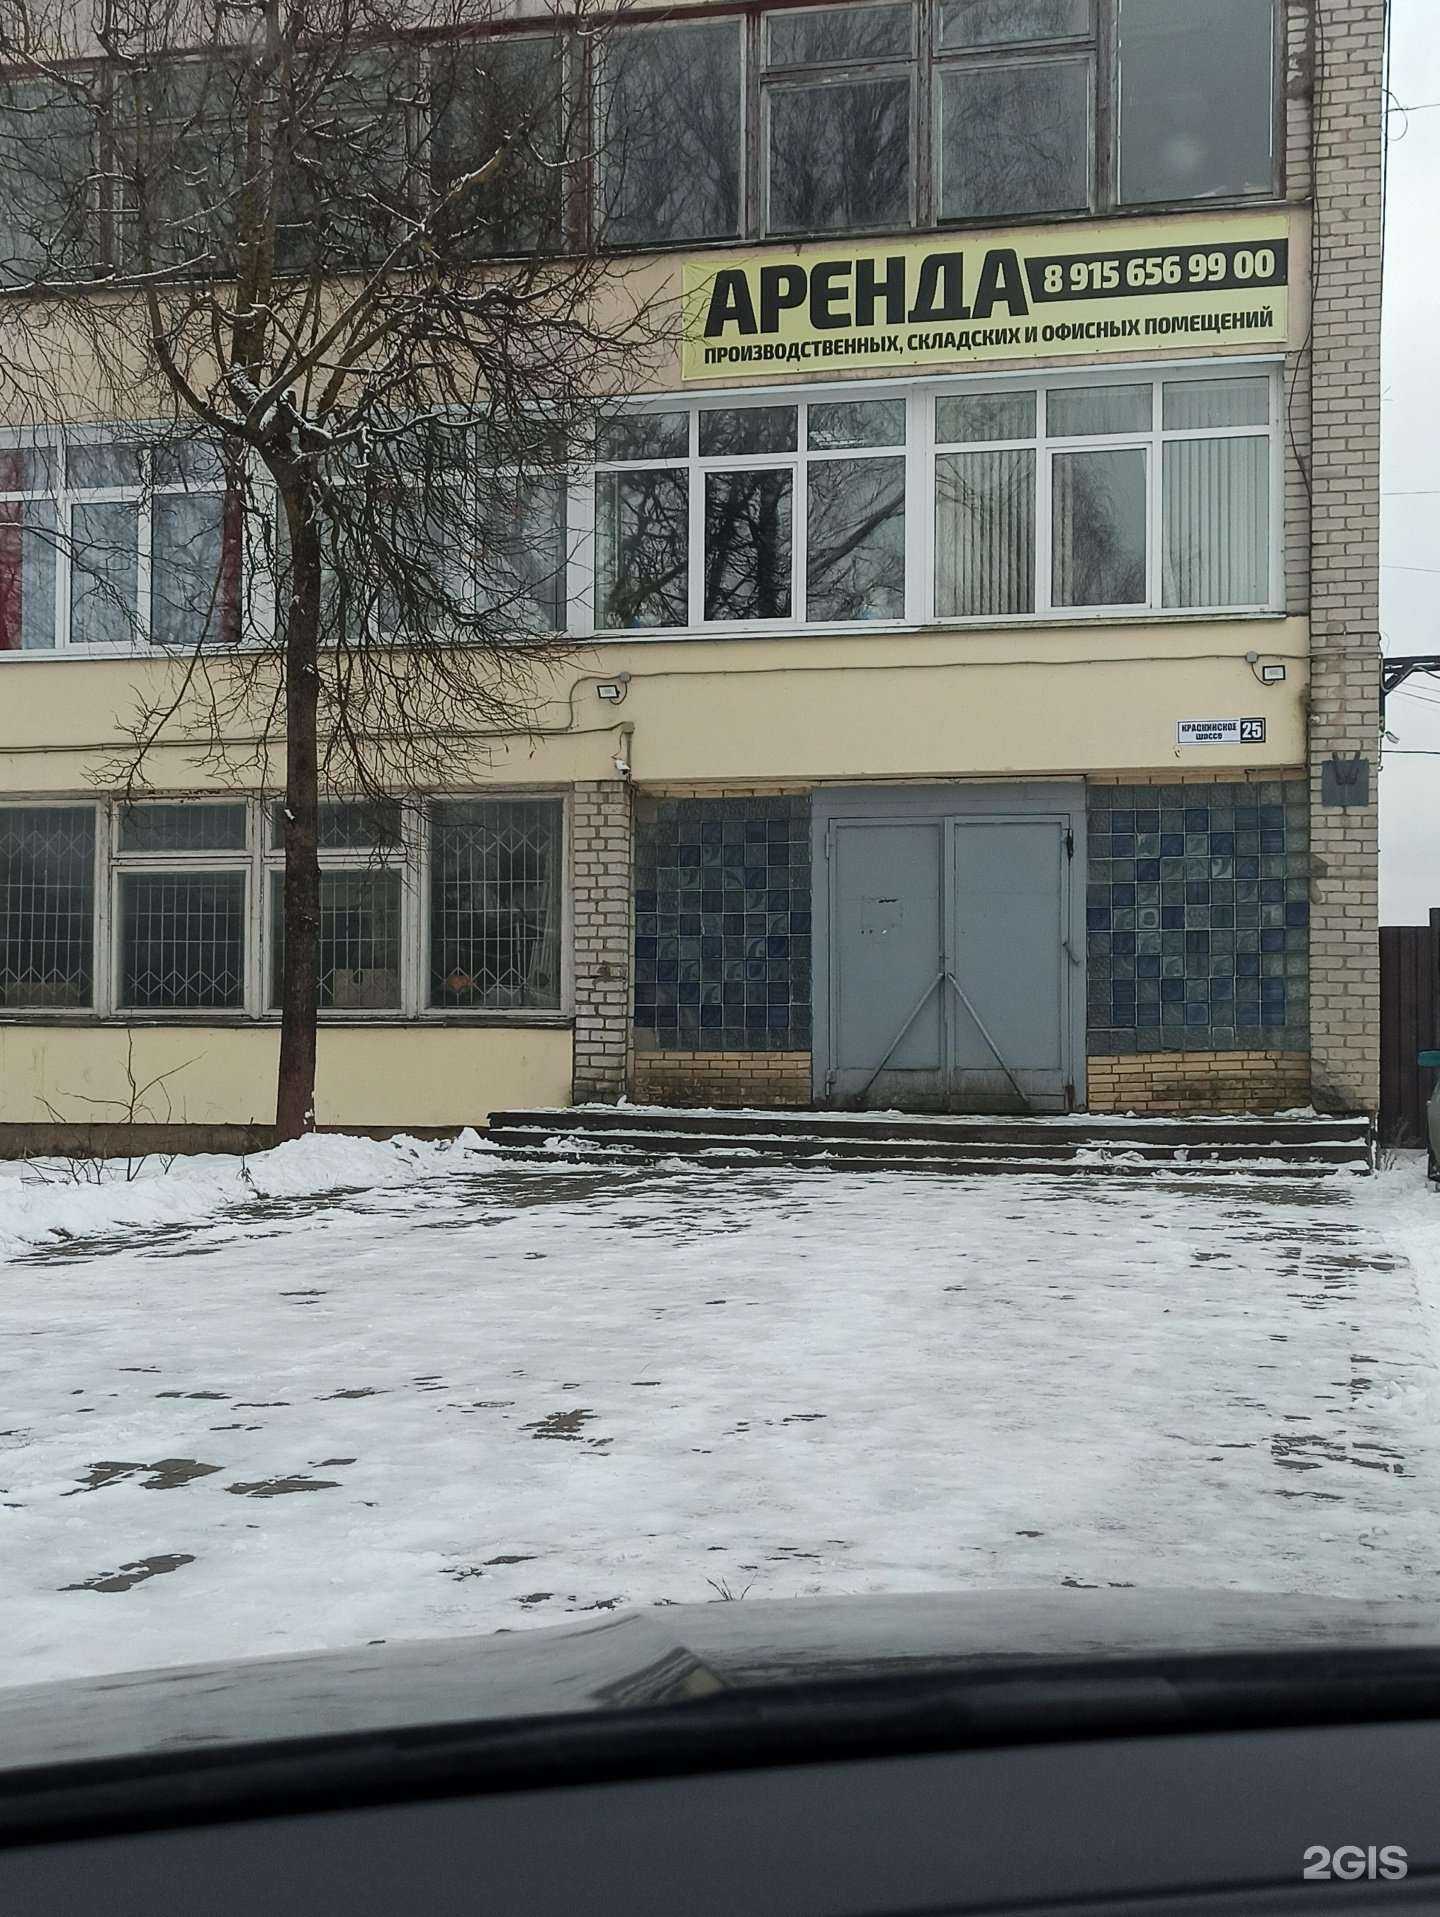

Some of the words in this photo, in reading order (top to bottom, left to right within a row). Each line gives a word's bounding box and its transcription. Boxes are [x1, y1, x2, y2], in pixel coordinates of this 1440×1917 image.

[704, 248, 1029, 338] АРЕНДА
[1043, 264, 1064, 293] 8
[1070, 259, 1120, 291] 915
[1126, 255, 1181, 287] 656
[1188, 251, 1227, 283] 99
[1233, 248, 1275, 280] 00
[704, 335, 904, 364] ПРОИЗВОДСТВЕННЫХ,
[907, 325, 1021, 352] СКЛАДСКИХ
[1024, 325, 1038, 343] И
[1042, 318, 1140, 342] ОФИСНЫХ
[1145, 305, 1273, 334] ПОМЕЩЕНИЙ
[1242, 722, 1262, 738] 25
